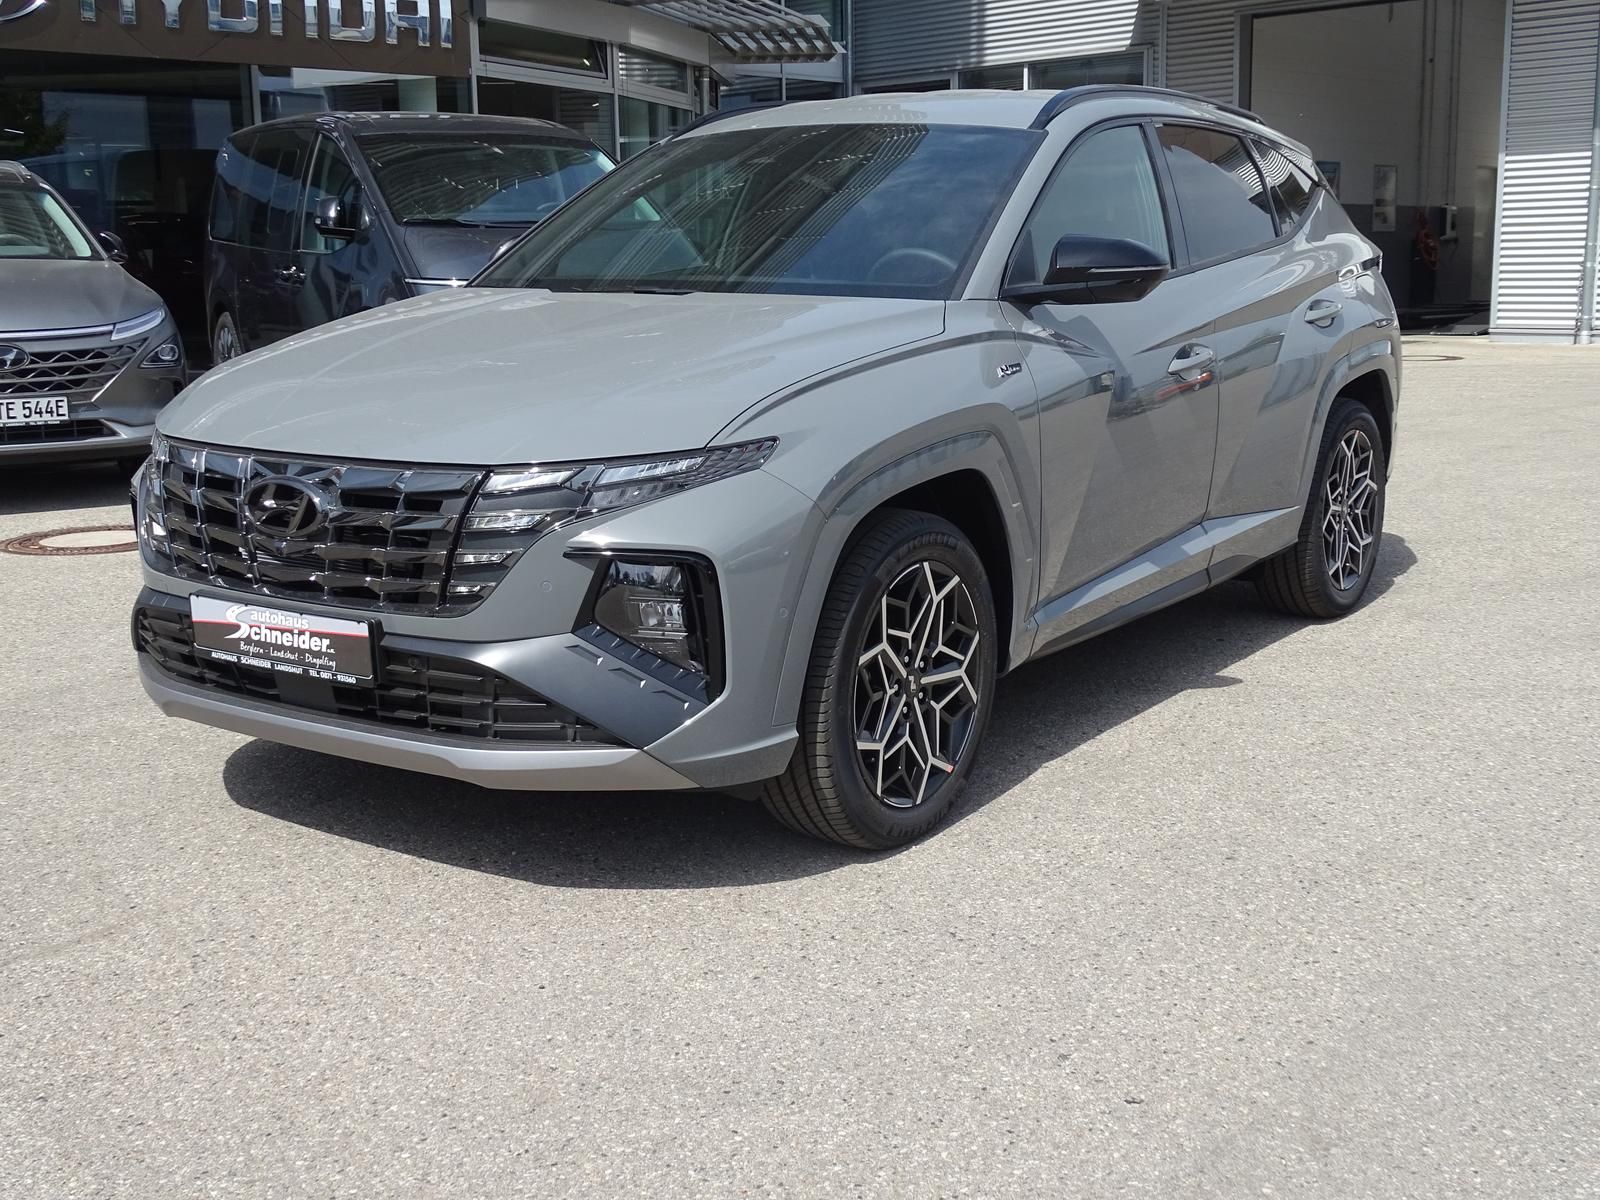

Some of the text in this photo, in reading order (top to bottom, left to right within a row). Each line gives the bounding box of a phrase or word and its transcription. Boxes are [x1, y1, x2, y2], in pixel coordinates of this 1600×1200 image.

[22, 399, 66, 419] 544E
[250, 610, 310, 629] autohaus
[211, 651, 238, 662] AUTOHAUS
[240, 656, 272, 669] SCHNEIDER
[274, 663, 303, 674] LANDSHUT
